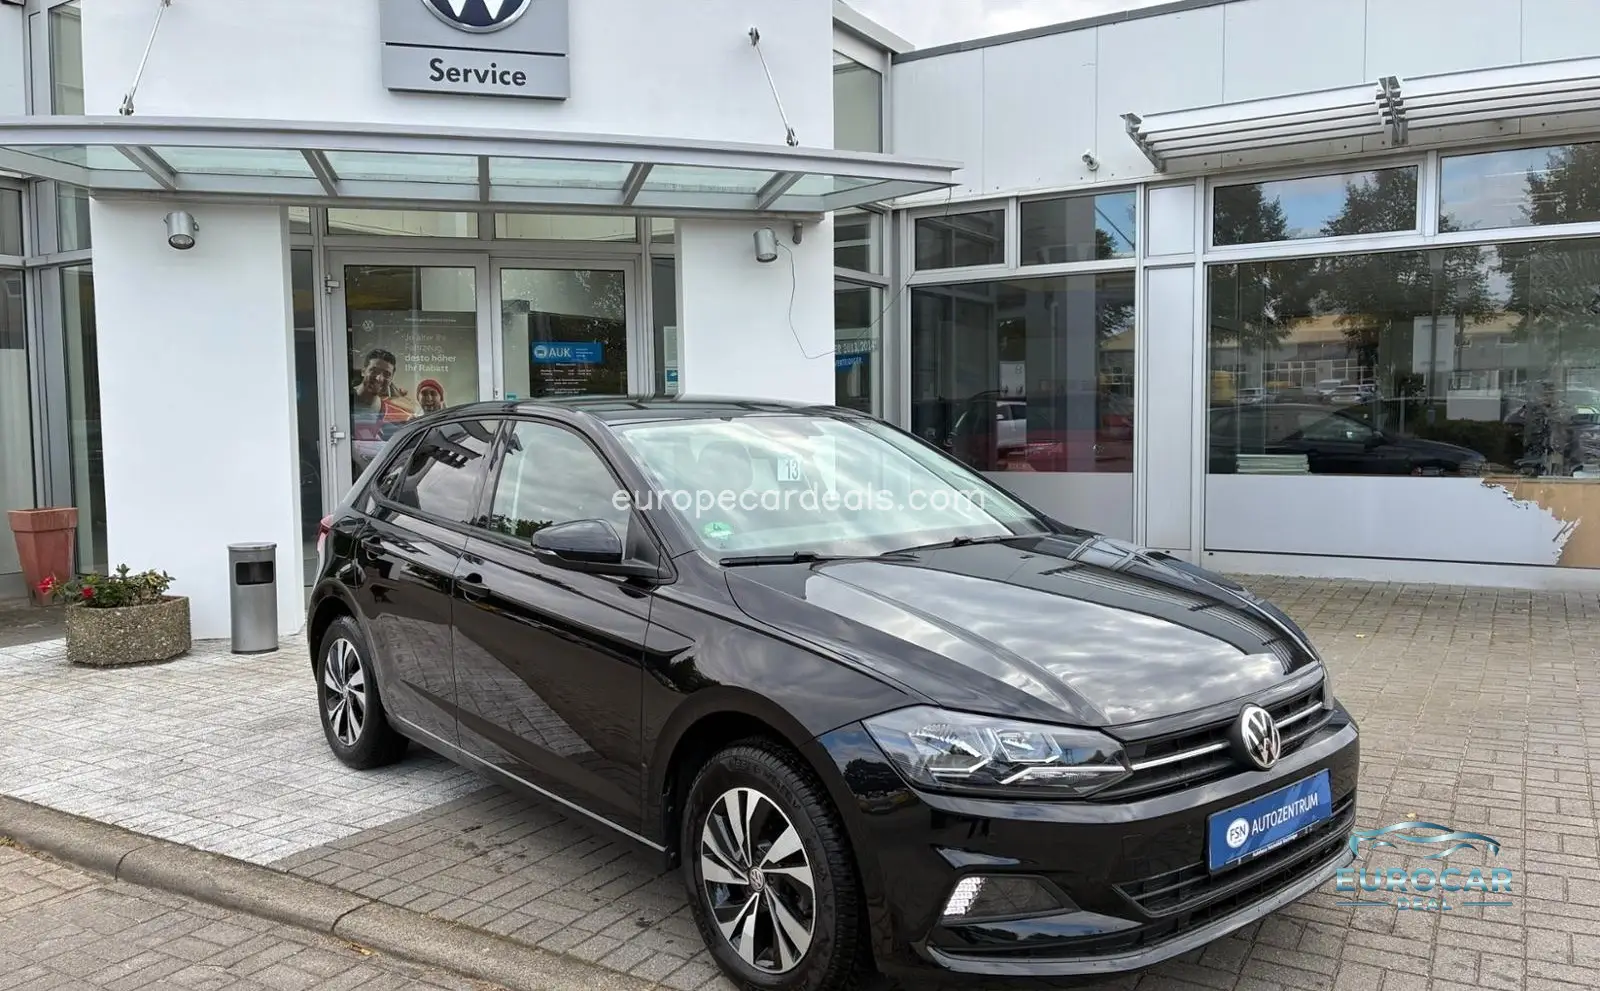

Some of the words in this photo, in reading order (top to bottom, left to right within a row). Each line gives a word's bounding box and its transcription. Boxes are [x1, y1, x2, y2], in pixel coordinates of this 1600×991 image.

[429, 57, 527, 87] Service
[404, 354, 430, 362] desto
[431, 354, 457, 362] höher
[548, 347, 571, 358] AUK
[418, 363, 449, 373] Rabatt
[785, 459, 799, 480] 13
[1229, 823, 1246, 841] FSN
[1251, 792, 1319, 836] AUTOZENTRUM
